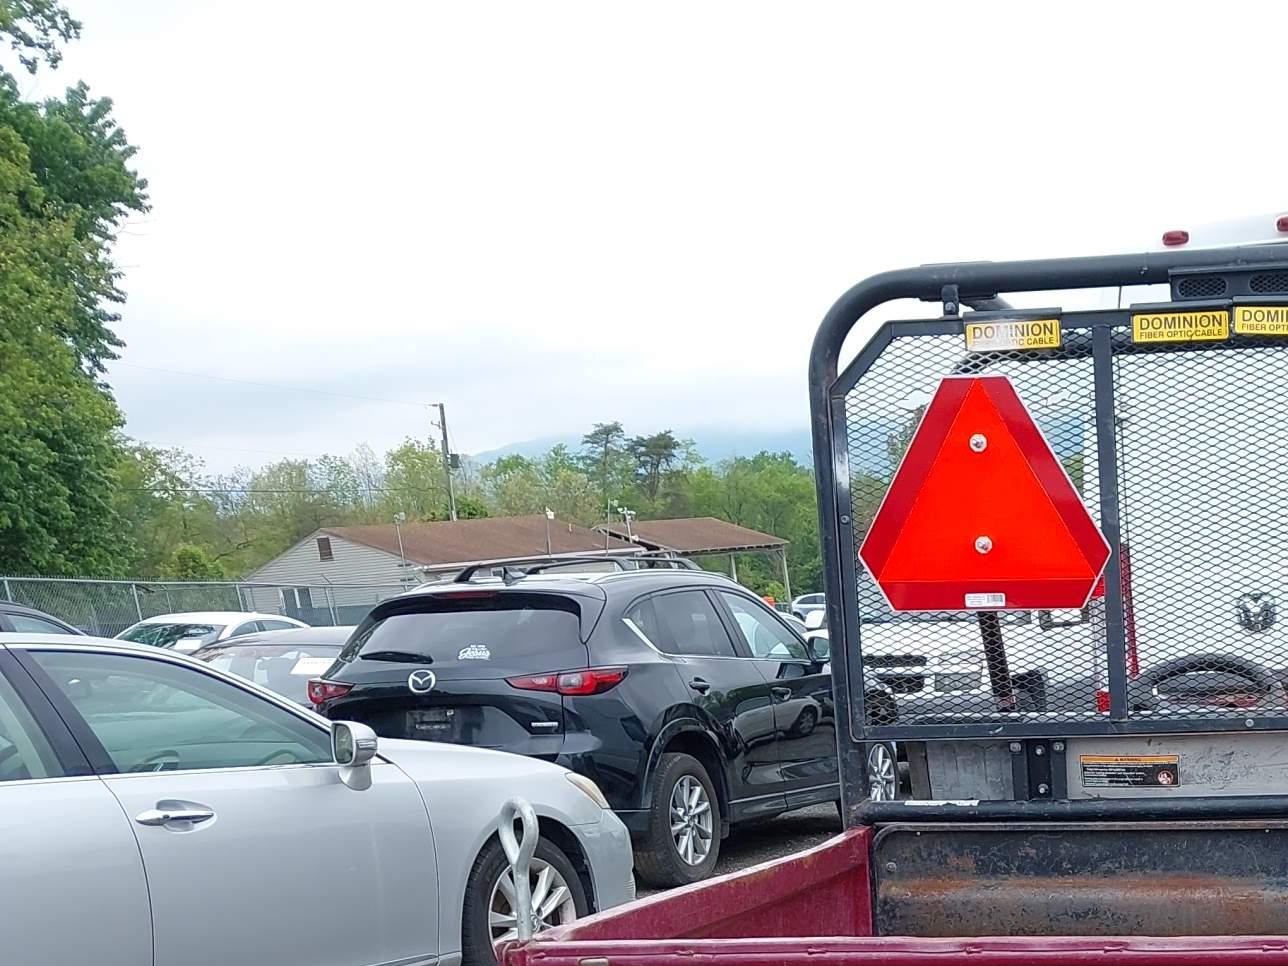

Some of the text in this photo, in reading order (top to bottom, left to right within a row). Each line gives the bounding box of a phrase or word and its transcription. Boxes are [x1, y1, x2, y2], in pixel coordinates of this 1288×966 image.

[1139, 314, 1222, 330] DOMINION
[1241, 323, 1267, 332] FIBER
[972, 322, 1053, 339] DOMINION
[1139, 328, 1222, 339] FIBER OPTIC CABLE
[1026, 337, 1054, 346] CABLE
